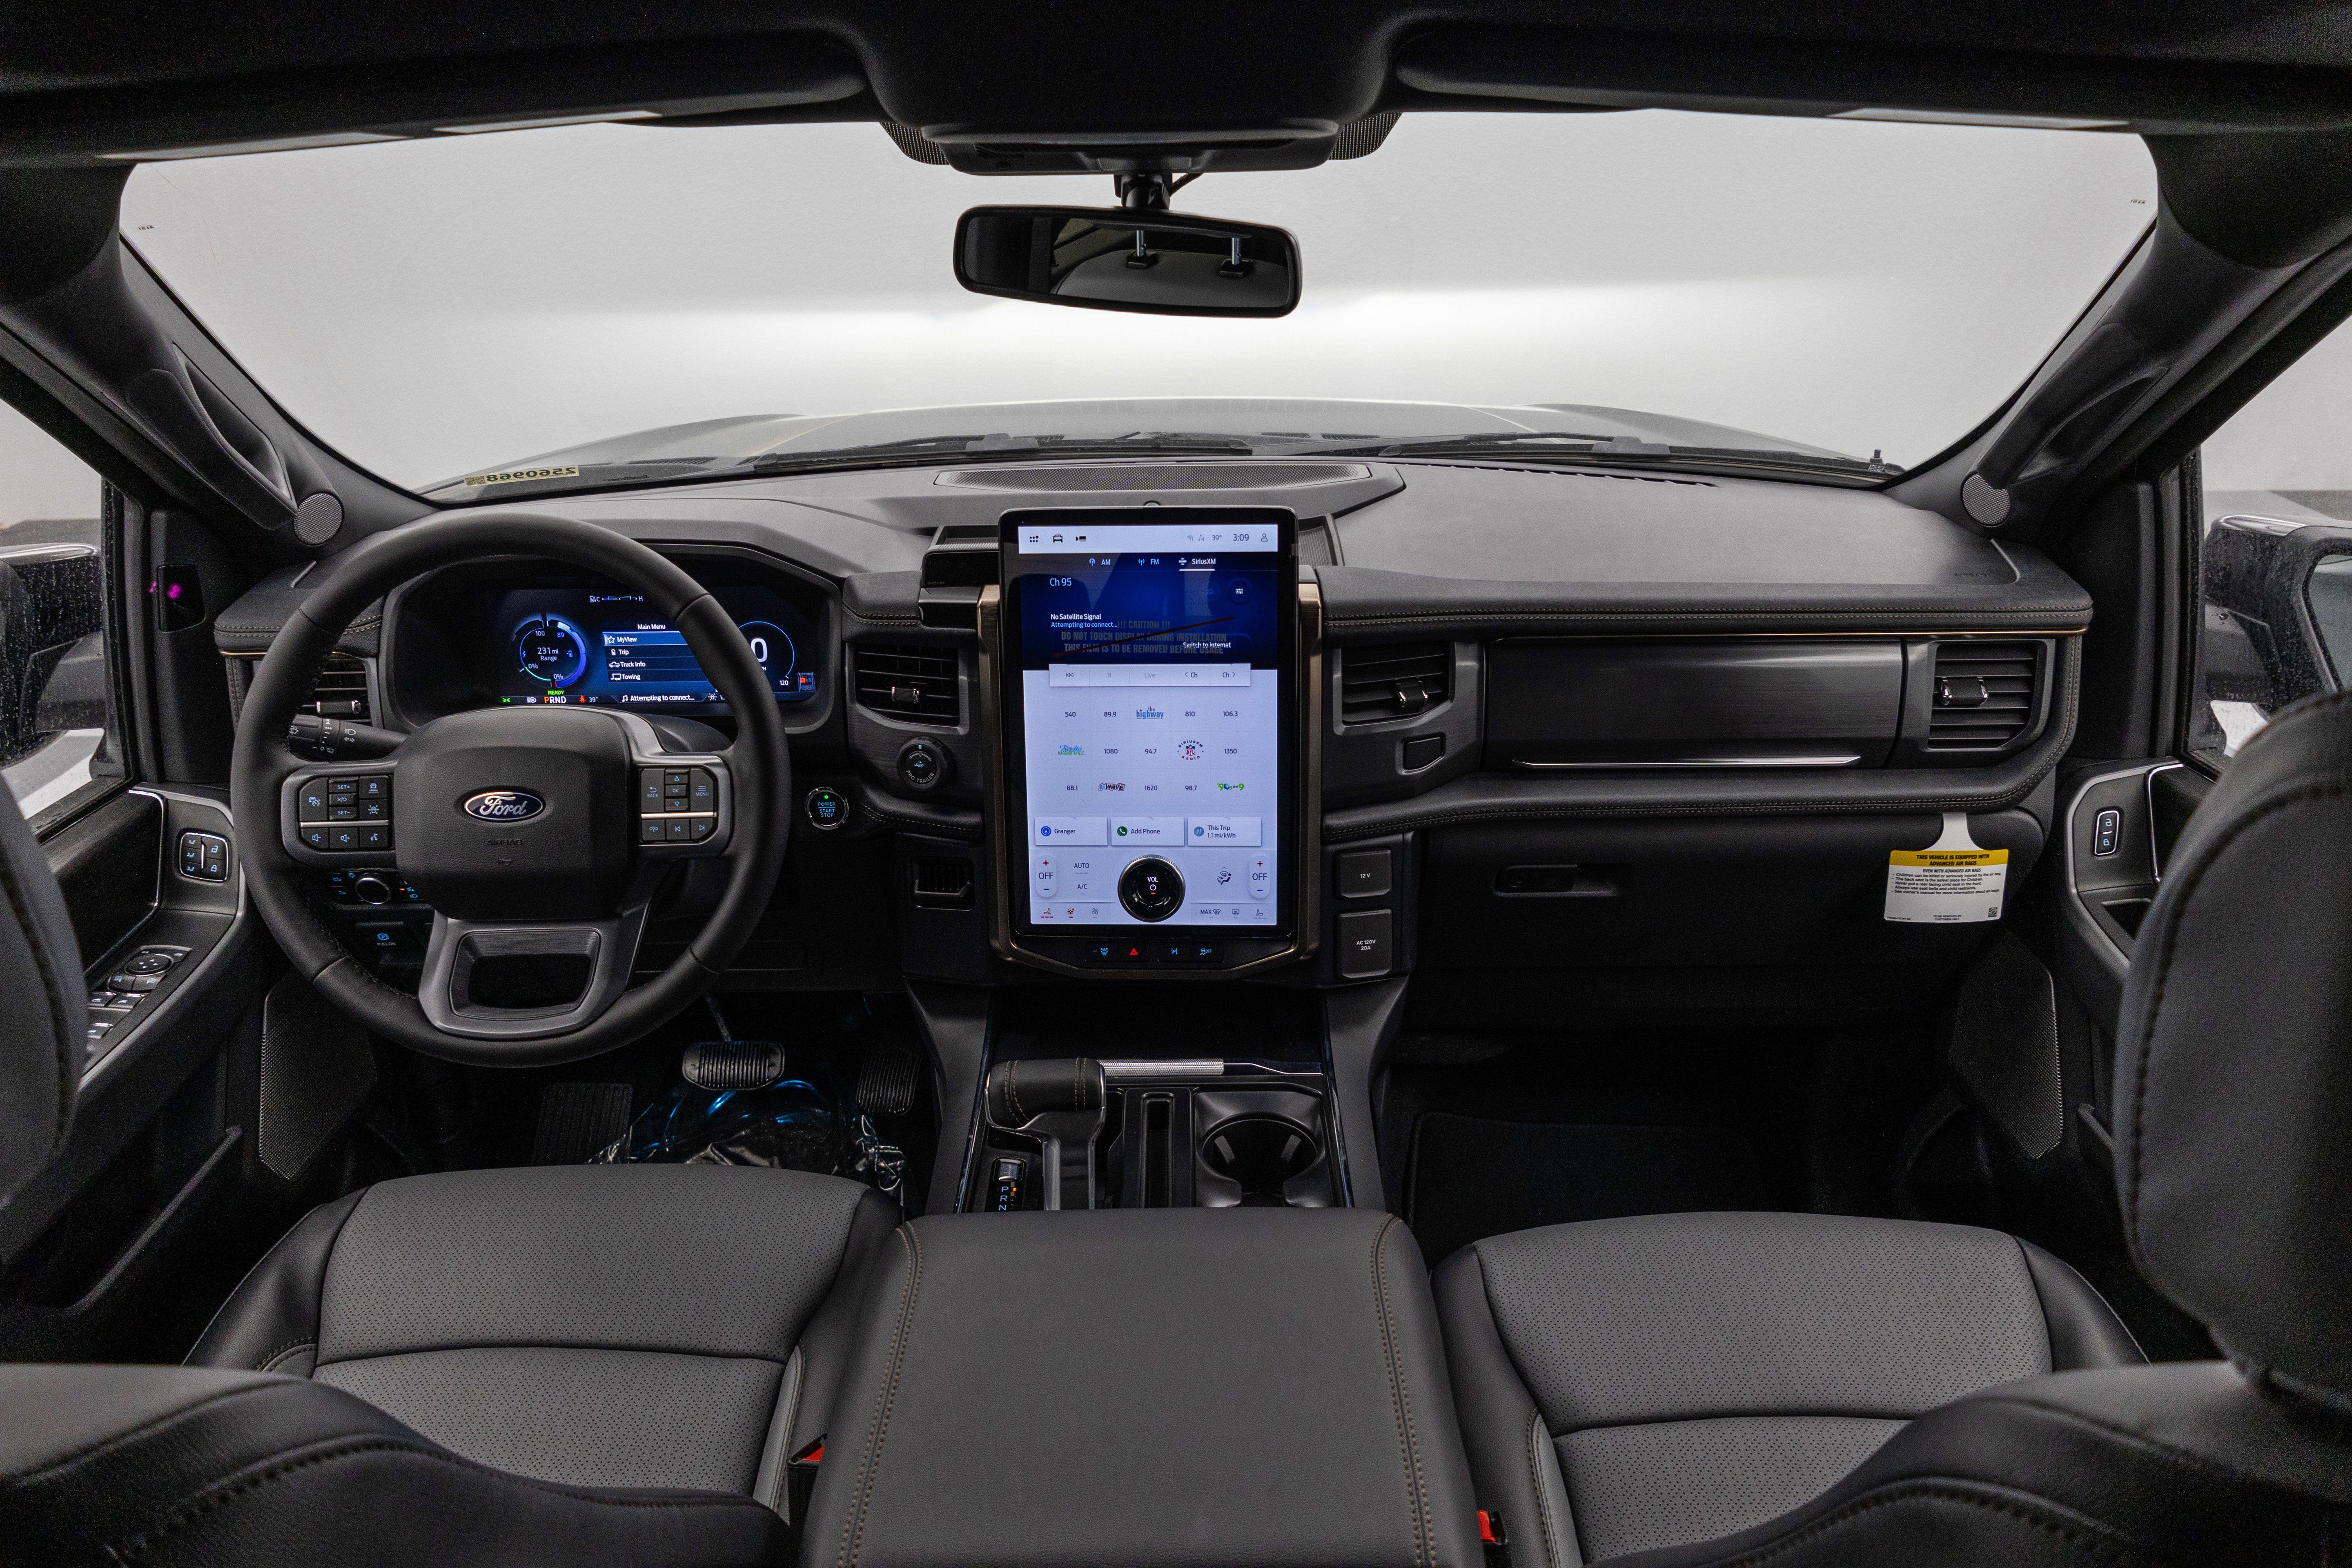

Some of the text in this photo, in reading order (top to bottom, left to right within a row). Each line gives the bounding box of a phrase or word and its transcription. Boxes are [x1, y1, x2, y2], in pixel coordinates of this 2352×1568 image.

[1050, 578, 1072, 586] Ch 95
[1128, 621, 1159, 629] CAUTION
[1062, 632, 1071, 640] DO
[1073, 632, 1087, 640] NOT
[1090, 632, 1113, 640] TOUCH
[1115, 633, 1144, 641] DISPLAY
[1176, 633, 1227, 642] INSTALLATION
[1064, 644, 1080, 652] THIS
[1111, 644, 1120, 653] TO
[1124, 644, 1131, 653] BE
[1133, 645, 1167, 653] REMOVED
[1170, 645, 1197, 653] BEFORE
[1136, 710, 1164, 719] highway
[906, 770, 935, 783] PRO TRAILER
[480, 795, 528, 815] Ford
